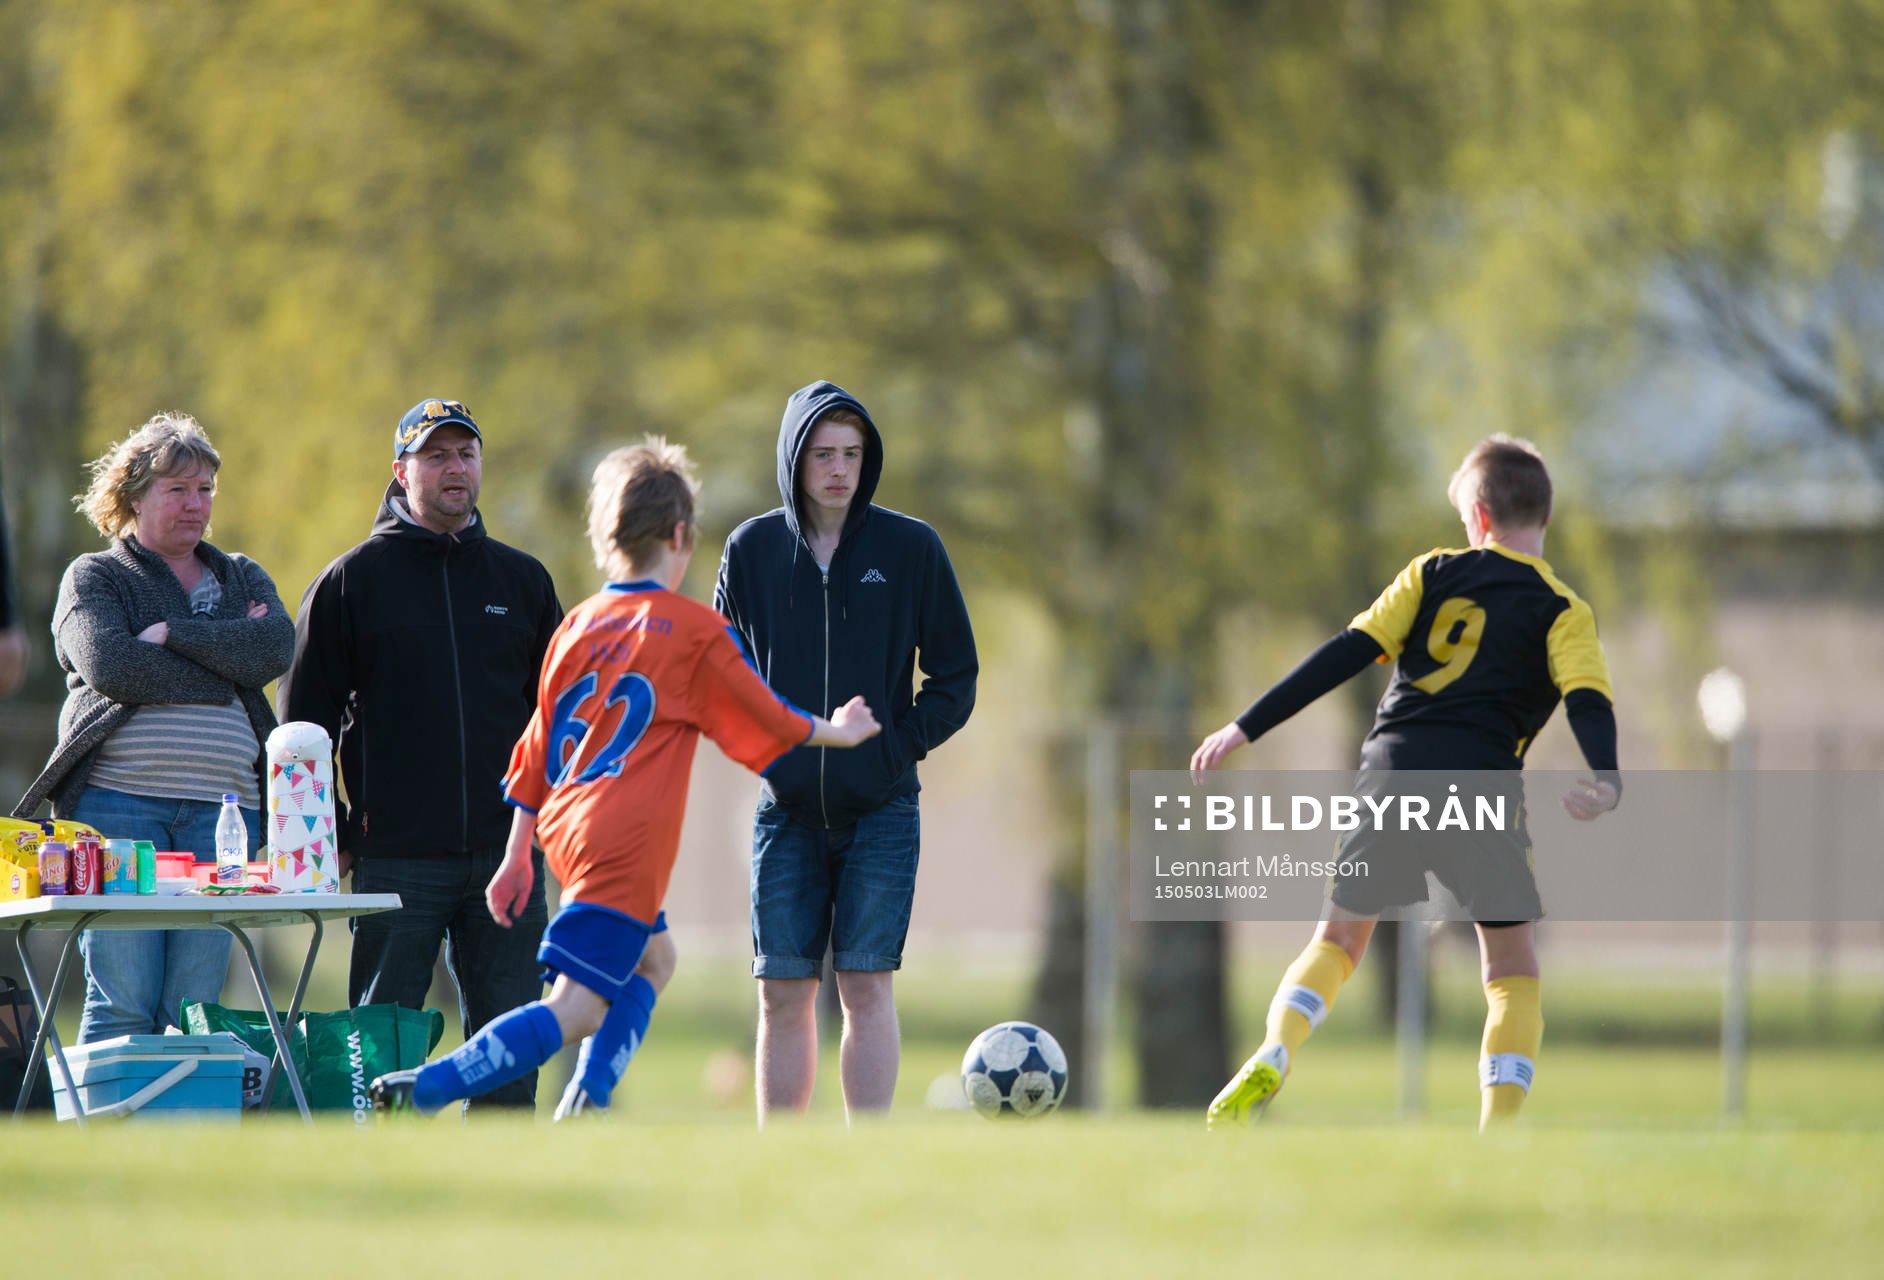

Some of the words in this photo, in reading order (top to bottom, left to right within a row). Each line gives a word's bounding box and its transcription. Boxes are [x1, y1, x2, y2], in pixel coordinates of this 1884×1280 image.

[1411, 597, 1486, 695] 9
[544, 670, 656, 790] 62
[218, 847, 243, 858] LOKA
[347, 1030, 372, 1131] www.öo
